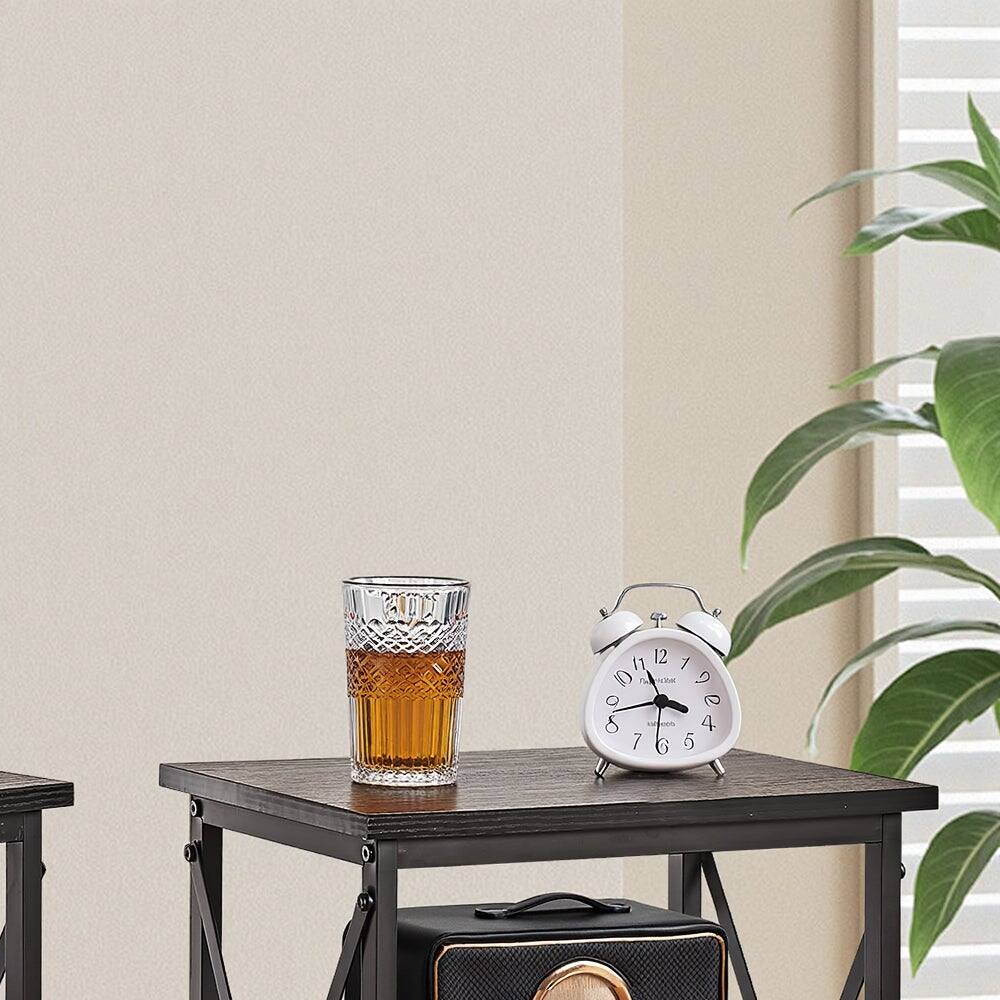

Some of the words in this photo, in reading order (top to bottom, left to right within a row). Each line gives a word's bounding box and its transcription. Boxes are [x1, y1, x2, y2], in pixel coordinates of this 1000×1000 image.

[632, 656, 647, 671] 11
[654, 648, 668, 664] 12
[605, 714, 619, 734] 8
[701, 715, 716, 731] 4
[633, 733, 642, 750] 7
[655, 737, 669, 755] 6
[684, 733, 695, 750] 5
